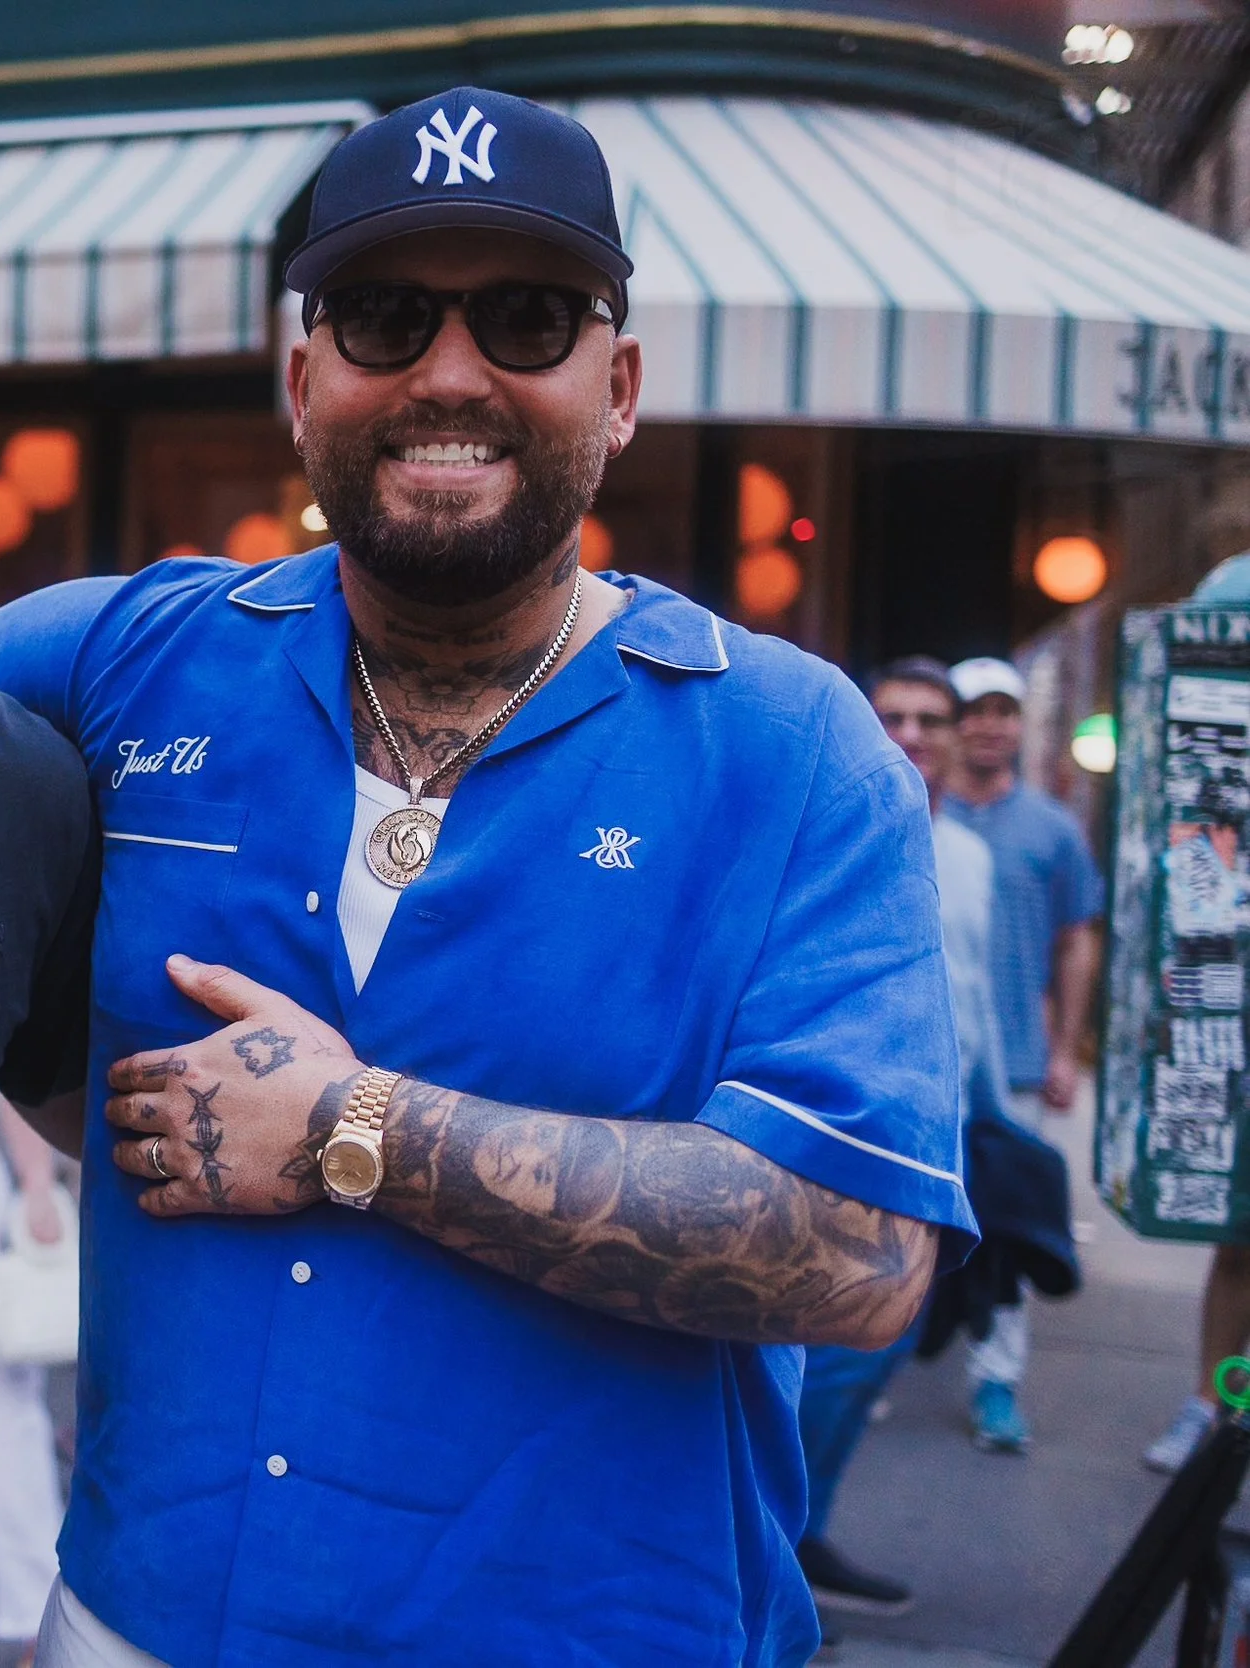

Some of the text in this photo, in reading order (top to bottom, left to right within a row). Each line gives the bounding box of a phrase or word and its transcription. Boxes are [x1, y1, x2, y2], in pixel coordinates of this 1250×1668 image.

[412, 105, 498, 186] NY
[112, 736, 211, 789] Just Us
